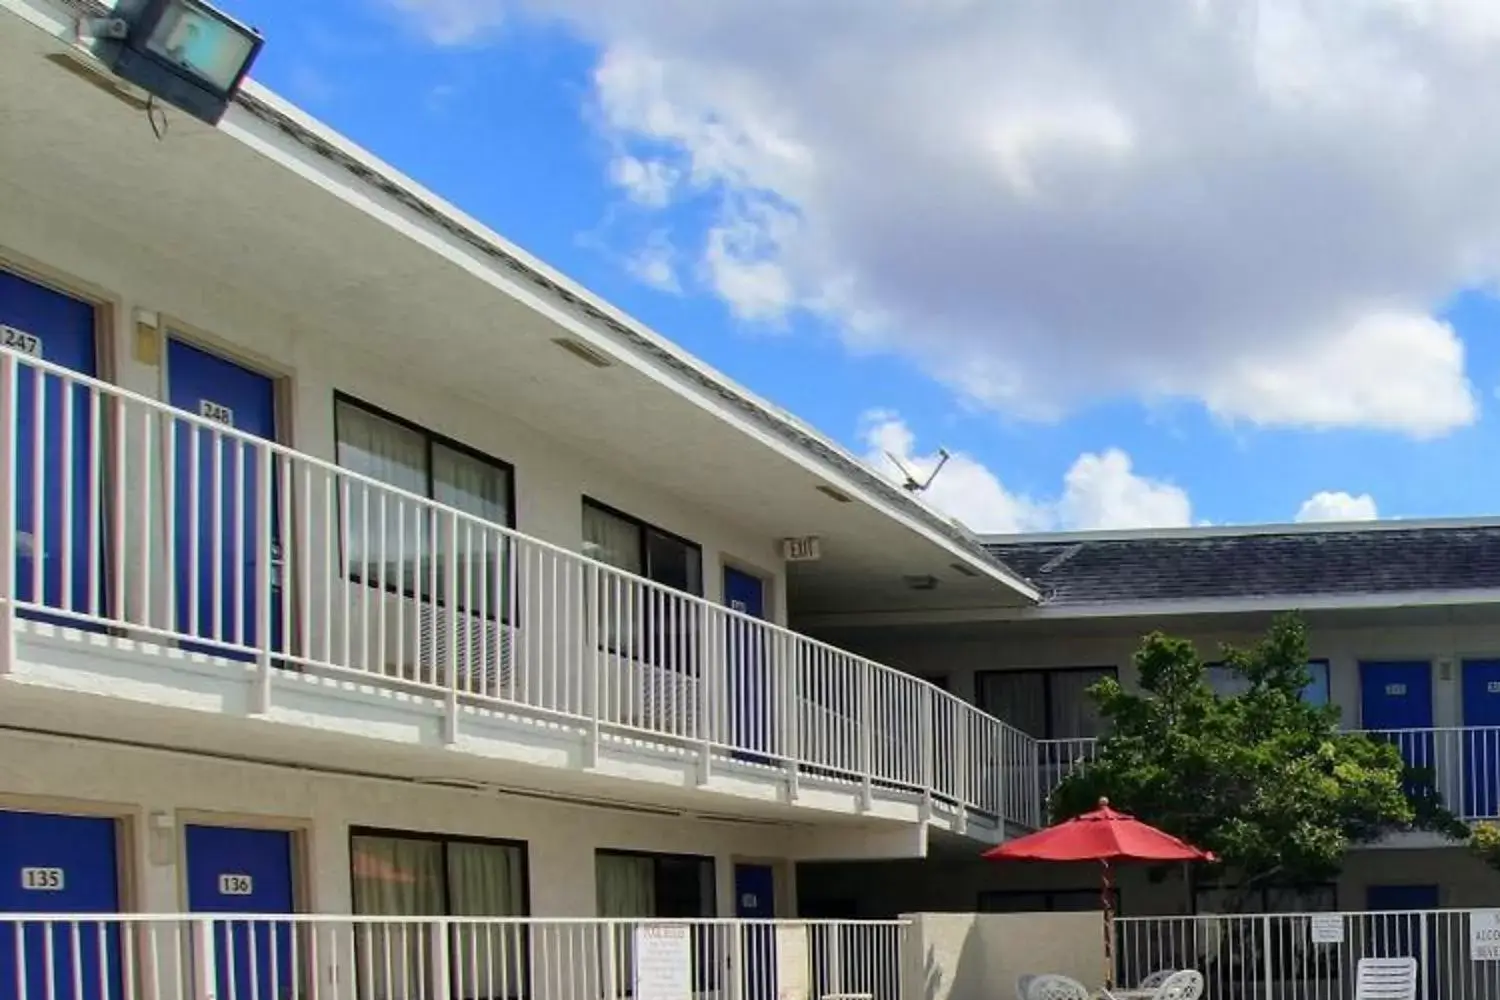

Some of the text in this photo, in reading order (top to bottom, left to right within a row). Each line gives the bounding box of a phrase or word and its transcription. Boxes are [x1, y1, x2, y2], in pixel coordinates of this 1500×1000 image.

[5, 328, 37, 353] 247
[203, 402, 229, 425] 248
[26, 870, 60, 888] 135
[222, 876, 249, 892] 136
